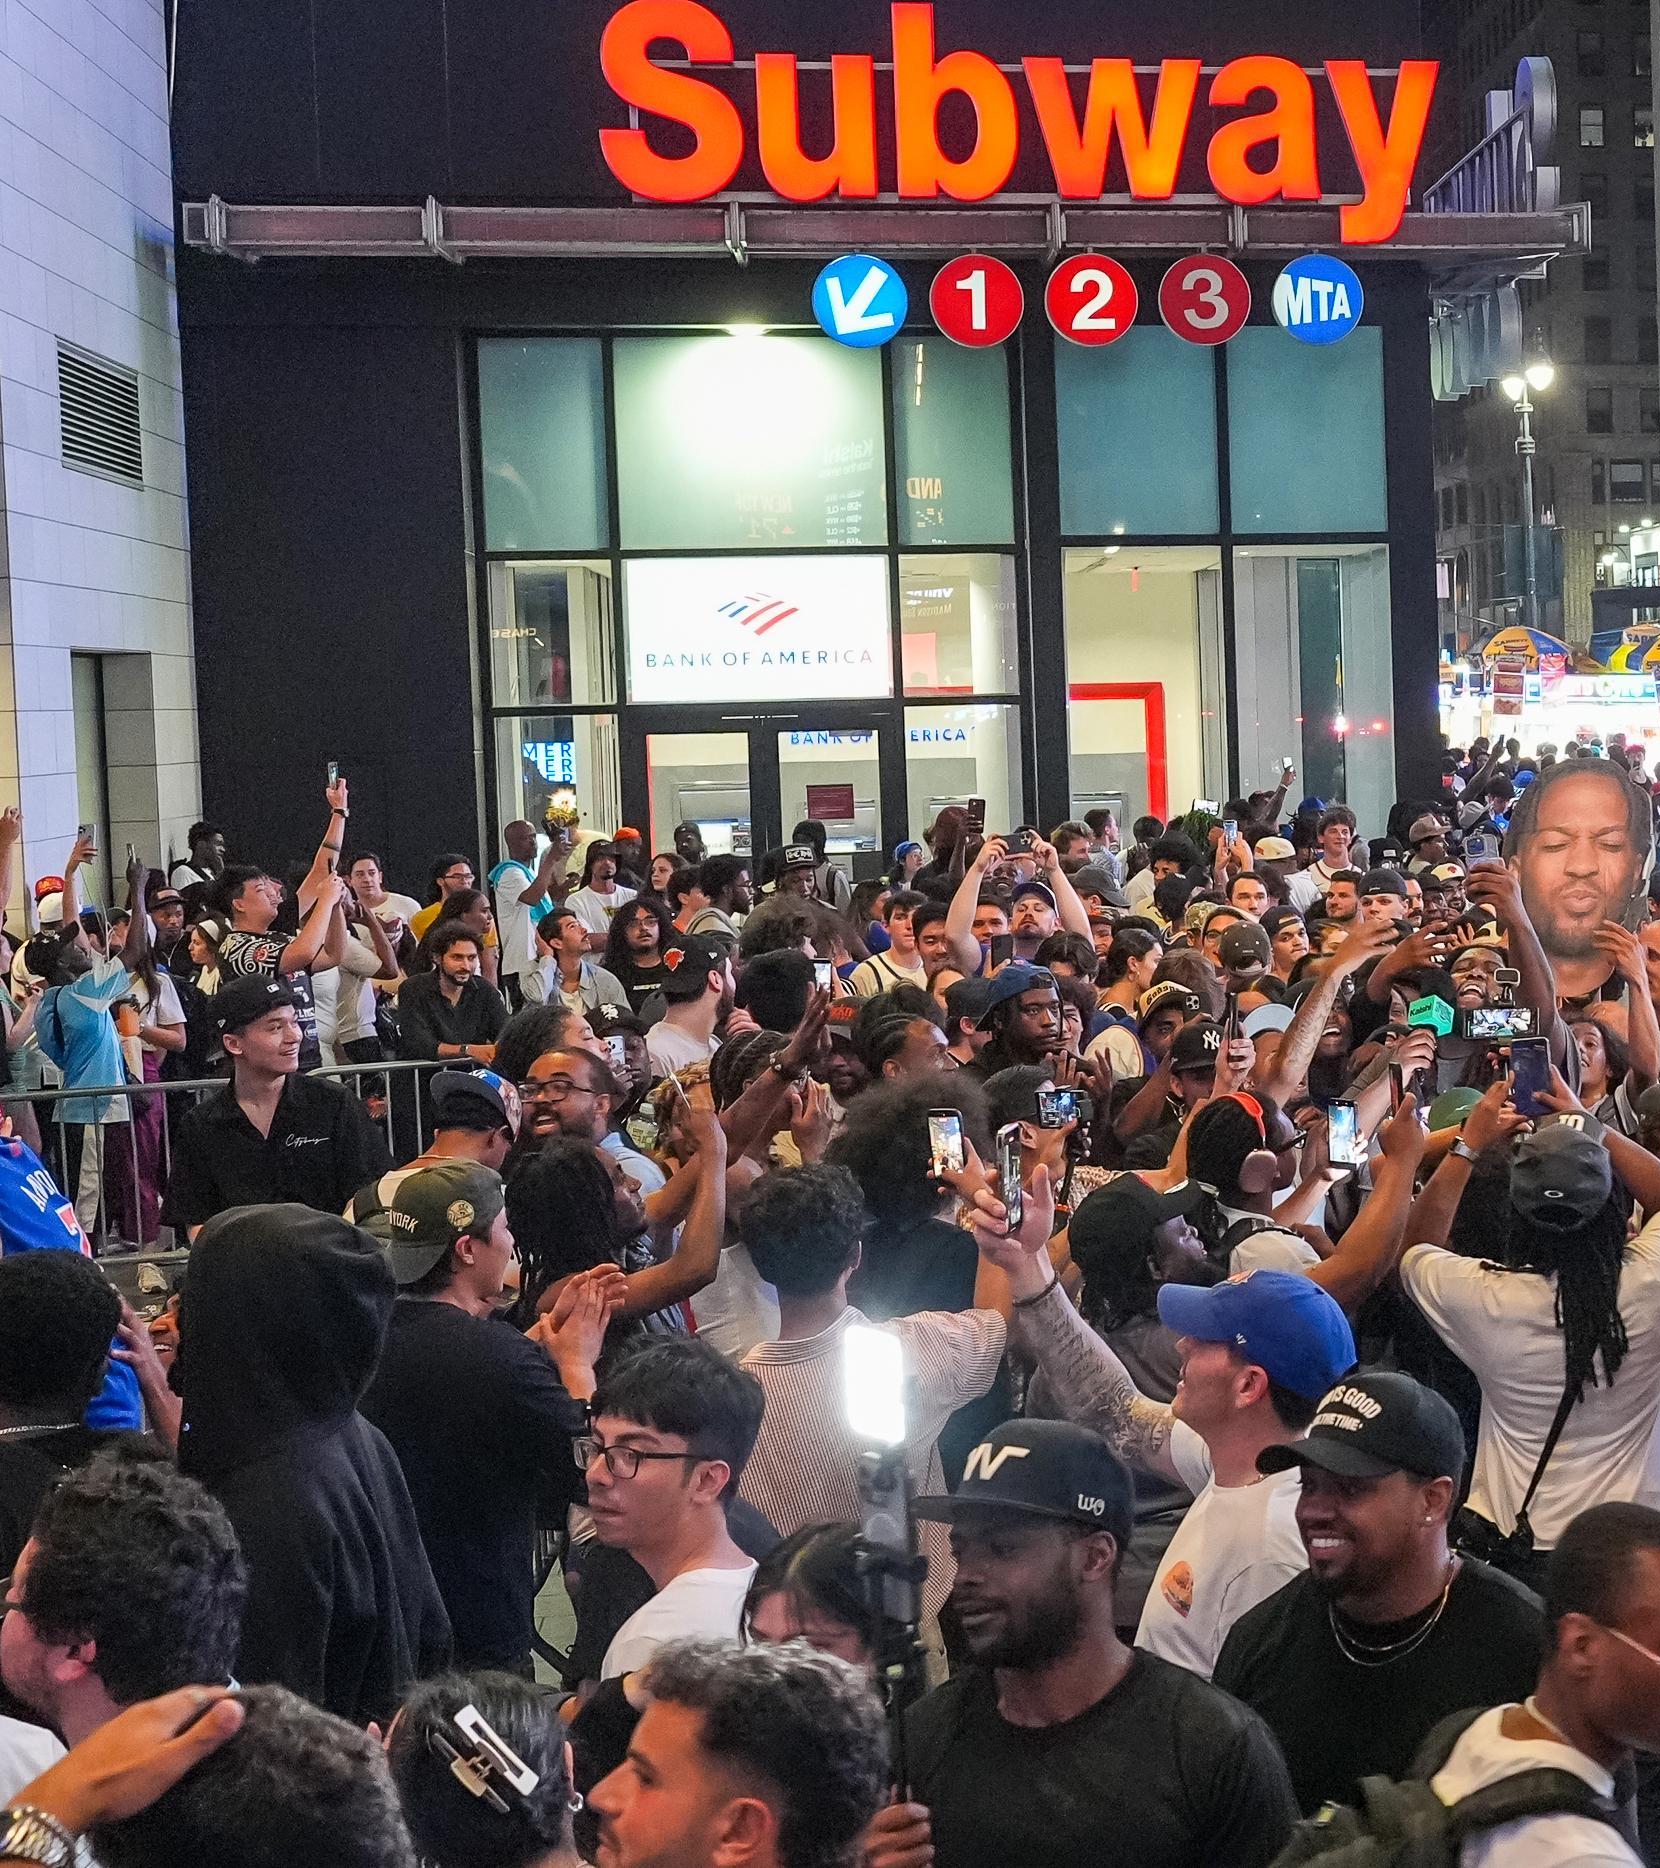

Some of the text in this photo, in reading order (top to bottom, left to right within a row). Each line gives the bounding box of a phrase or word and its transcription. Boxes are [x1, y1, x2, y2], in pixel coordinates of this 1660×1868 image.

[599, 0, 1439, 244] Subway
[956, 269, 987, 331] 1
[1071, 268, 1116, 331] 2
[1182, 268, 1230, 329] 3
[1276, 273, 1352, 327] MTA
[646, 649, 873, 668] BANK OF AMERICA
[911, 729, 966, 741] ERICA
[1410, 1003, 1431, 1016] Kalshi
[1203, 1030, 1221, 1050] NY
[1343, 1387, 1382, 1419] GOOD
